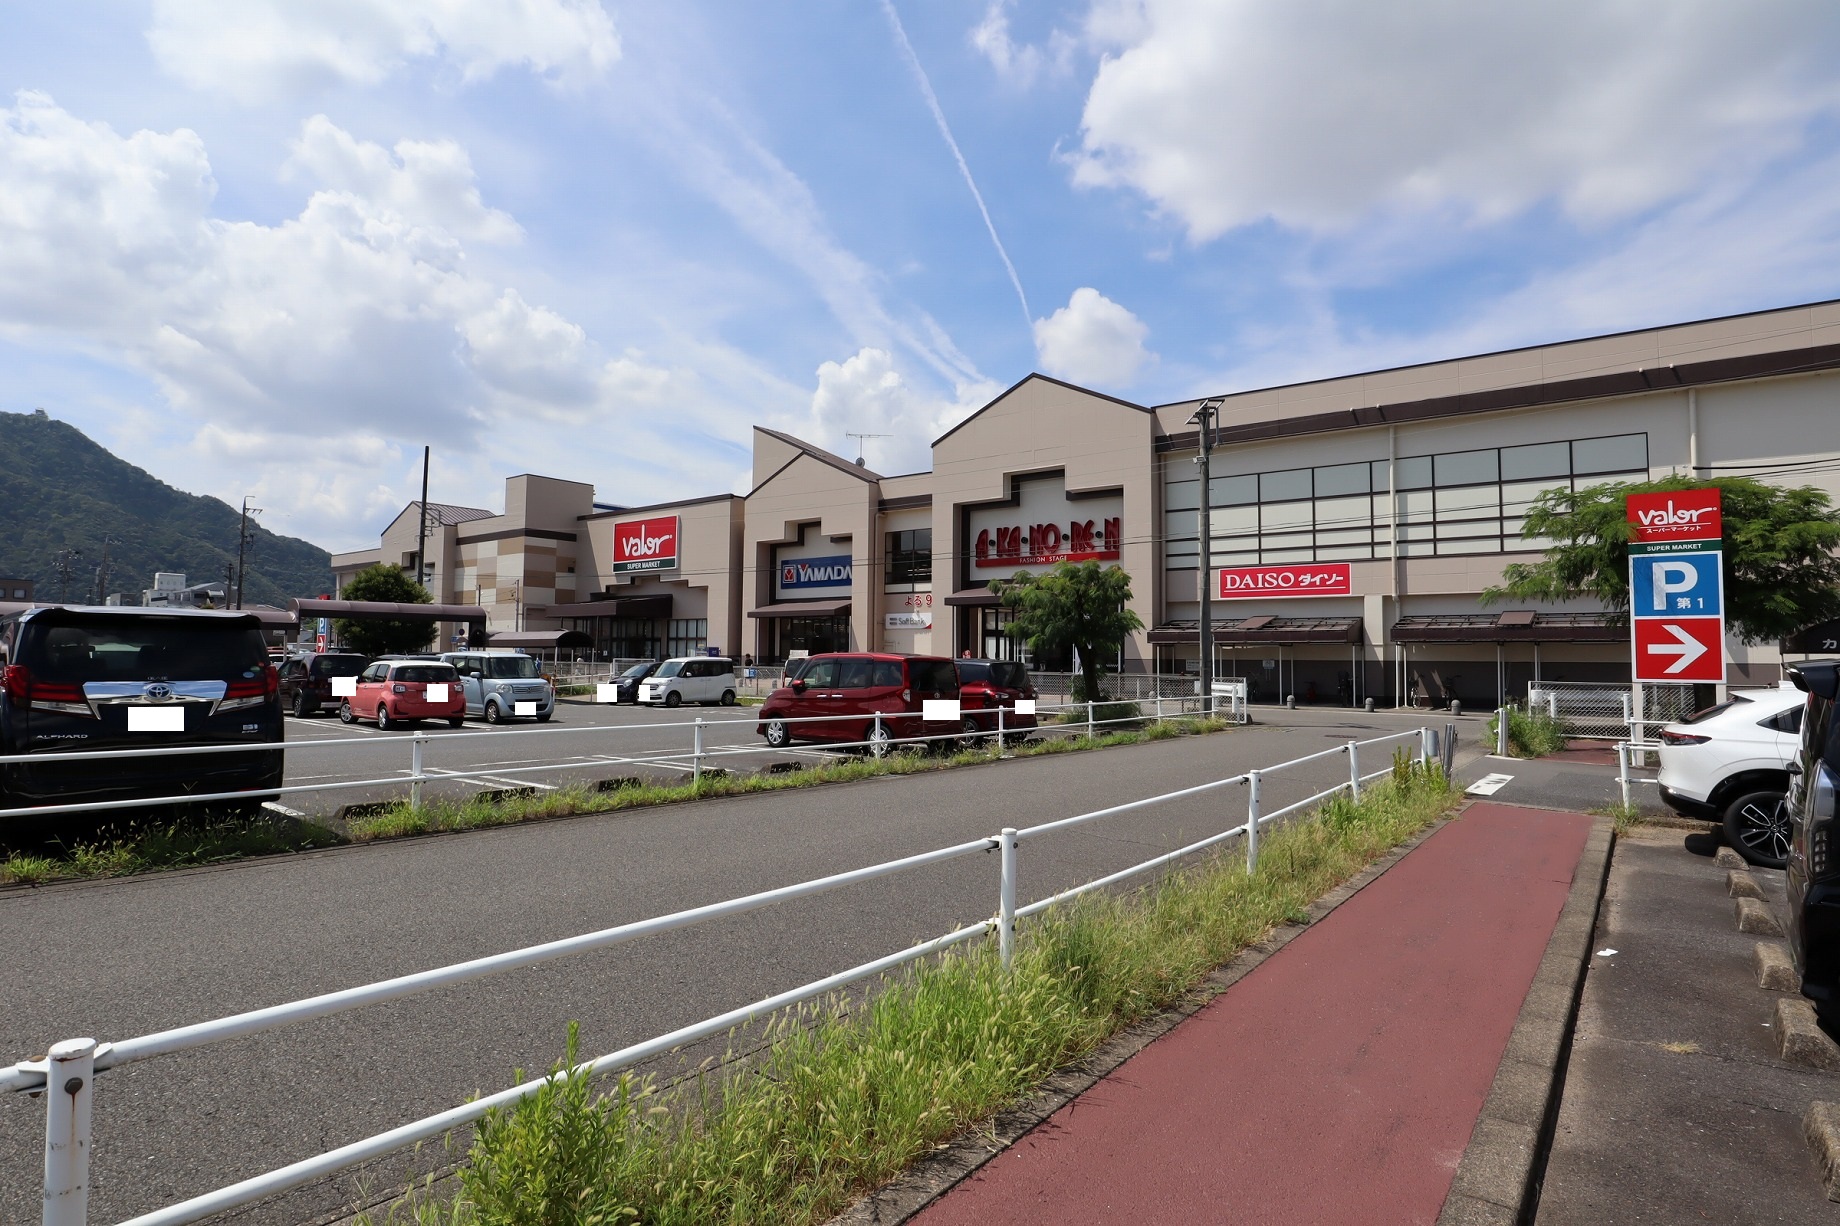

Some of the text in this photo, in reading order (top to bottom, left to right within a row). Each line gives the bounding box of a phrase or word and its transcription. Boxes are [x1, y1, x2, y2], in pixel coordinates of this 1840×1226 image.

[1638, 500, 1714, 526] valor
[1646, 526, 1702, 534] スーパーマーケット
[622, 524, 671, 557] valor
[1671, 543, 1702, 551] MARKET
[627, 560, 660, 570] SUPER MARKET
[797, 563, 852, 582] YAMADA
[1225, 572, 1344, 589] DAISO ダイソー
[1652, 561, 1699, 611] P
[898, 617, 926, 626] SoftBank
